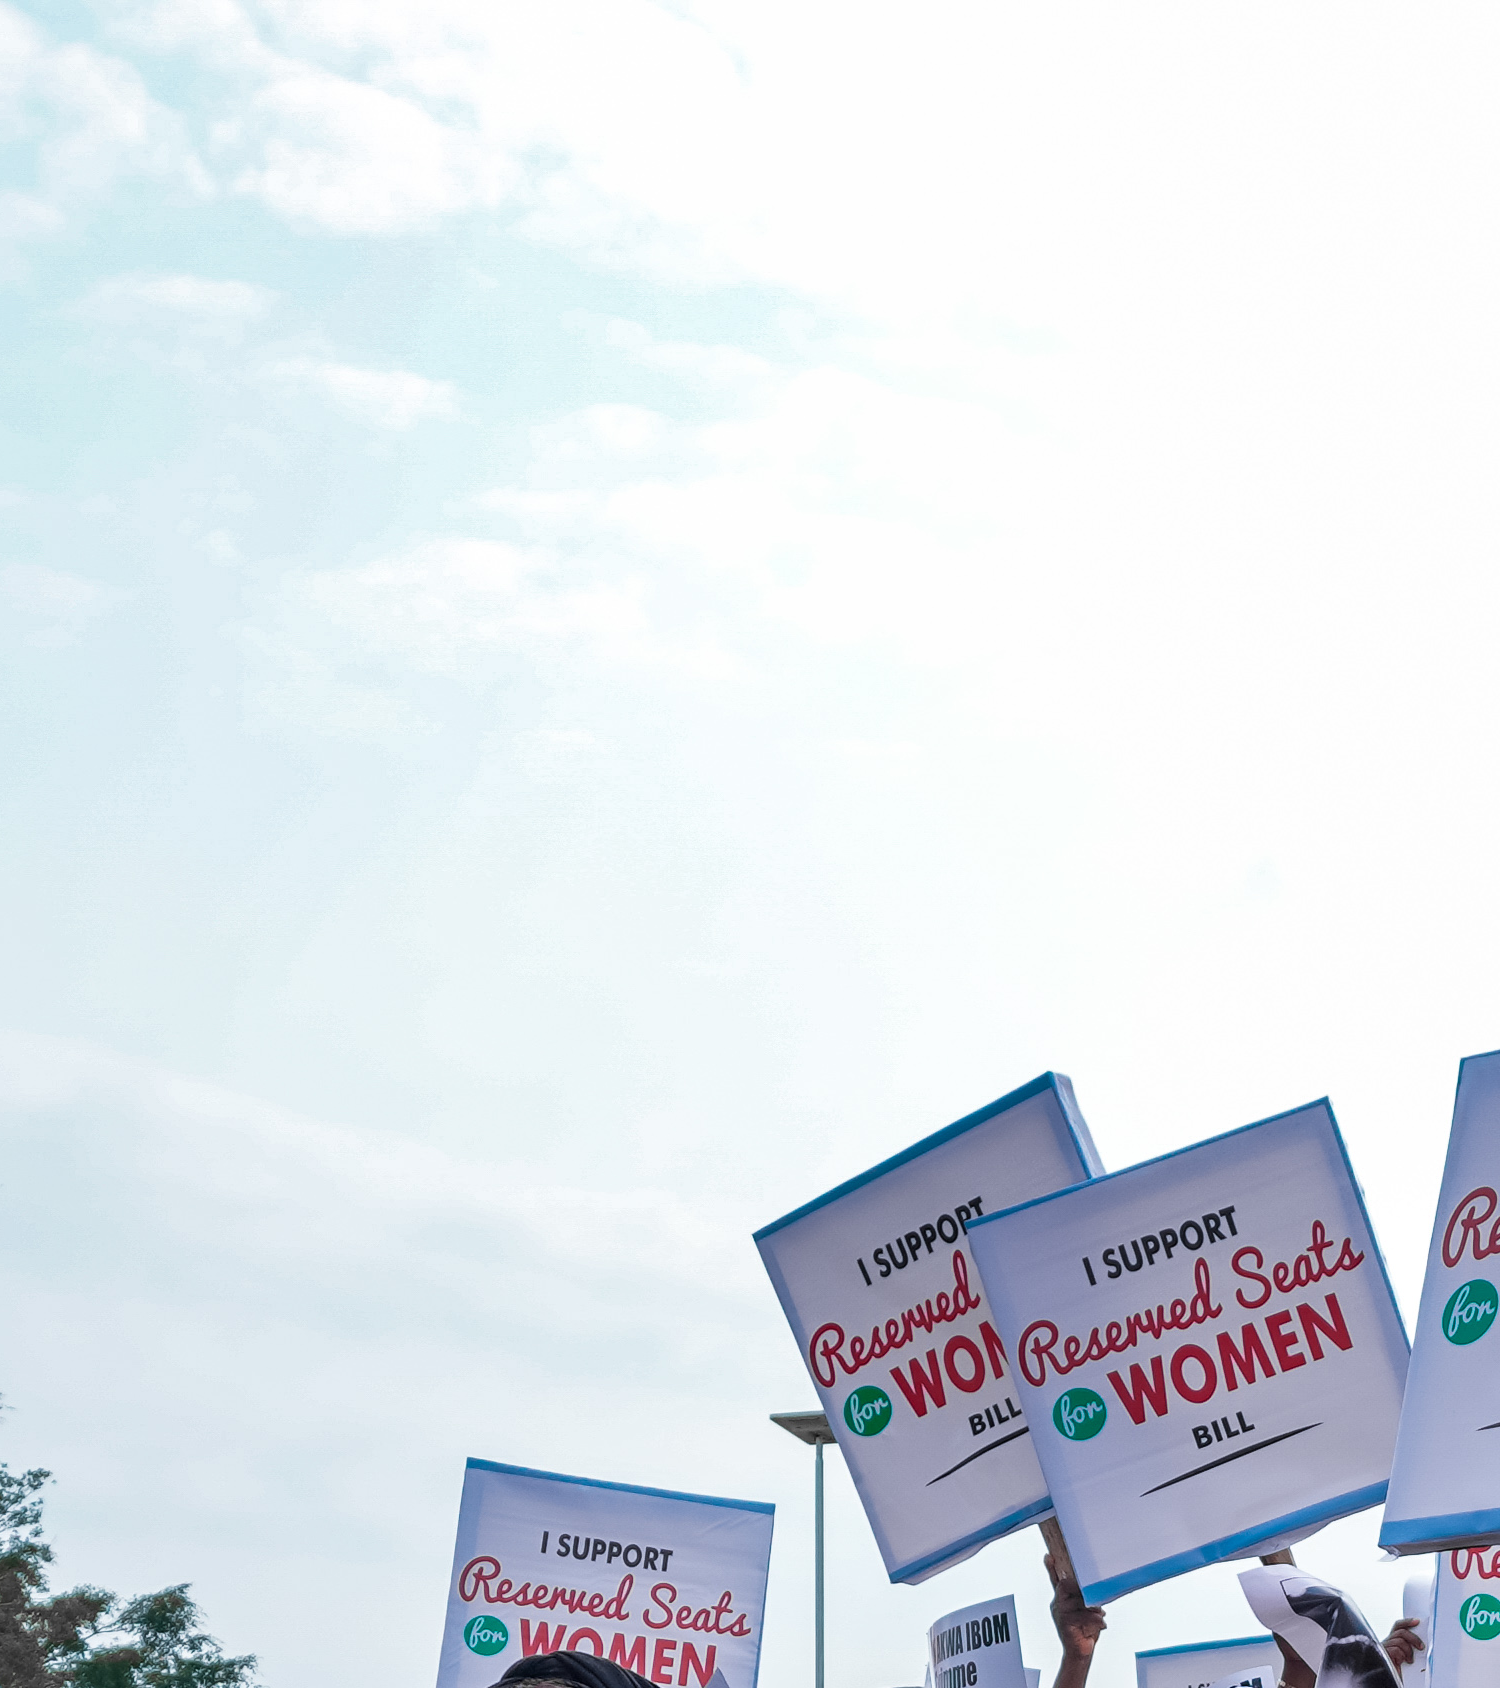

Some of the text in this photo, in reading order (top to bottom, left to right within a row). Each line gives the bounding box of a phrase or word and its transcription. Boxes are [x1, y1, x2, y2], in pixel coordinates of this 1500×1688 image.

[856, 1197, 985, 1286] I SUPPORT
[1082, 1205, 1239, 1286] I SUPPORT
[809, 1250, 981, 1388] Reserved
[1019, 1220, 1364, 1388] Reserved Seats
[1447, 1285, 1496, 1325] for
[1057, 1292, 1354, 1436] for WOMEN
[851, 1392, 889, 1432] for
[968, 1397, 1022, 1436] BILL
[1191, 1411, 1255, 1449] BILL
[541, 1531, 673, 1572] I SUPPORT
[459, 1555, 751, 1637] Reserved Seats
[470, 1619, 717, 1687] for WOMEN
[966, 1612, 1010, 1651] IBOM
